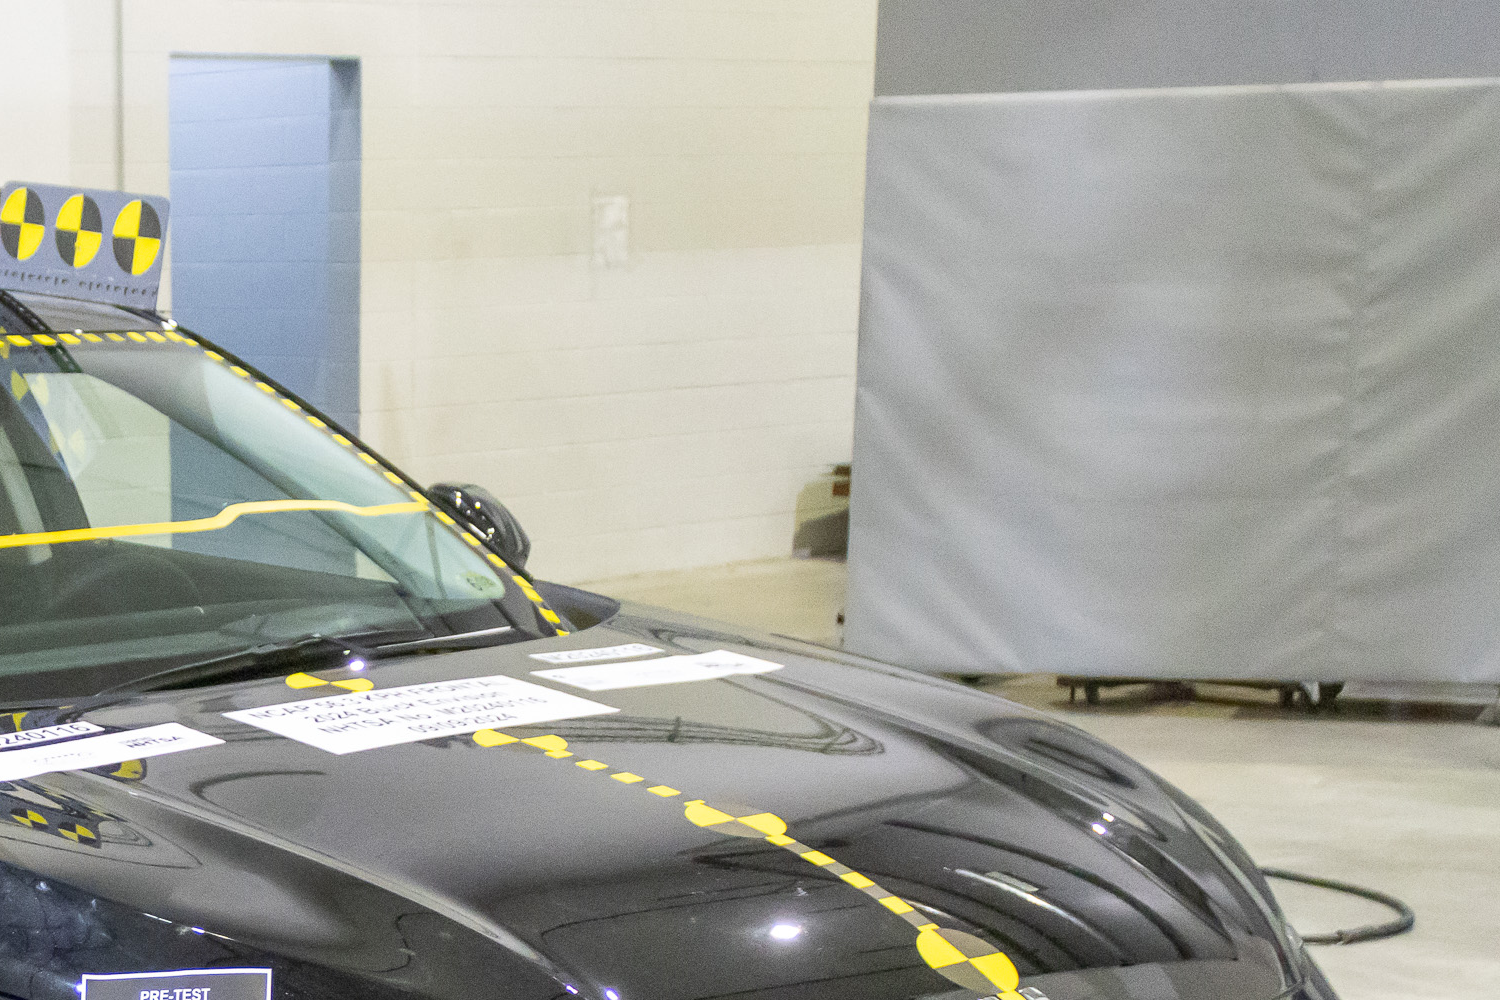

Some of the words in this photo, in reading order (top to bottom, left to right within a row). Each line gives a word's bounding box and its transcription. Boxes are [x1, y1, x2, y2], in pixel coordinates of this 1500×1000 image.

[248, 704, 309, 719] NCAP
[359, 688, 410, 702] KPH
[407, 681, 508, 695] FRONTAL
[304, 710, 358, 723] 2024
[357, 702, 415, 715] Buick
[417, 691, 508, 706] Envision
[317, 715, 397, 734] NHTSA
